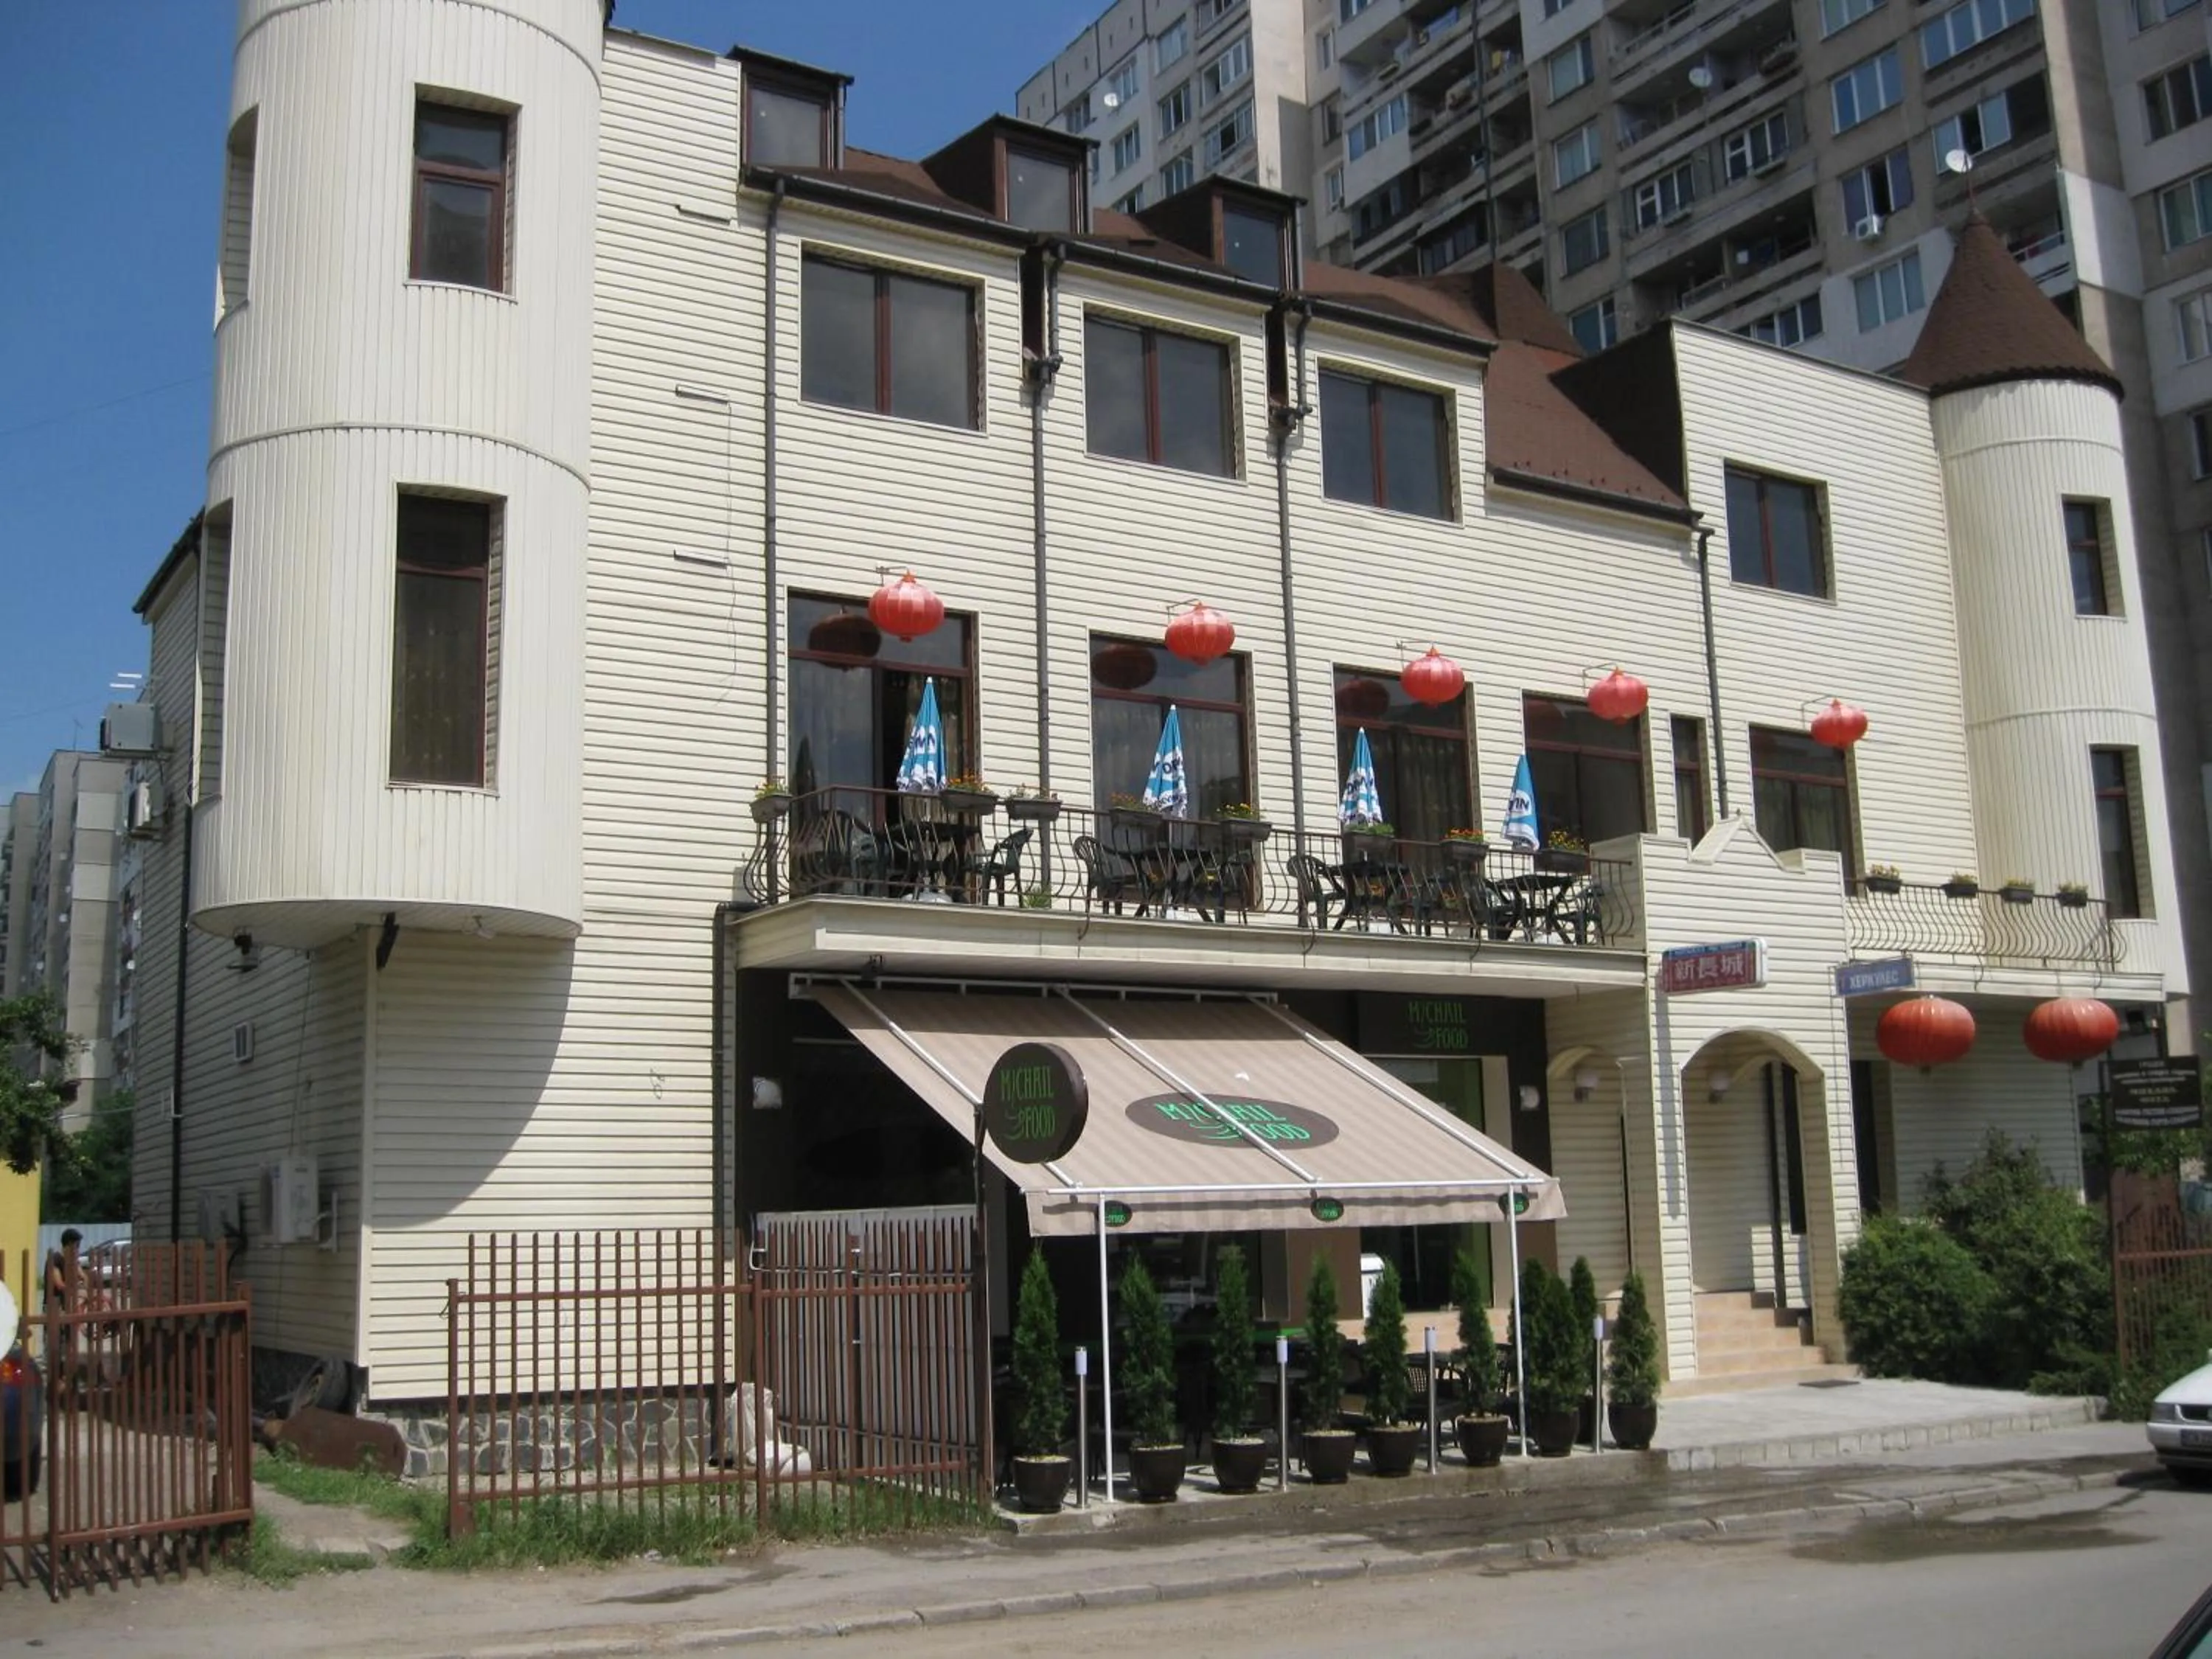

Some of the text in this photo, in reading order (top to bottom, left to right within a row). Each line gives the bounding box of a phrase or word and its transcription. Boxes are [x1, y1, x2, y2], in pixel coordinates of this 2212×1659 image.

[1849, 970, 1899, 990] ХЕРКУЛЕС
[1024, 1105, 1055, 1139] FOOD
[1237, 1122, 1310, 1140] OOD
